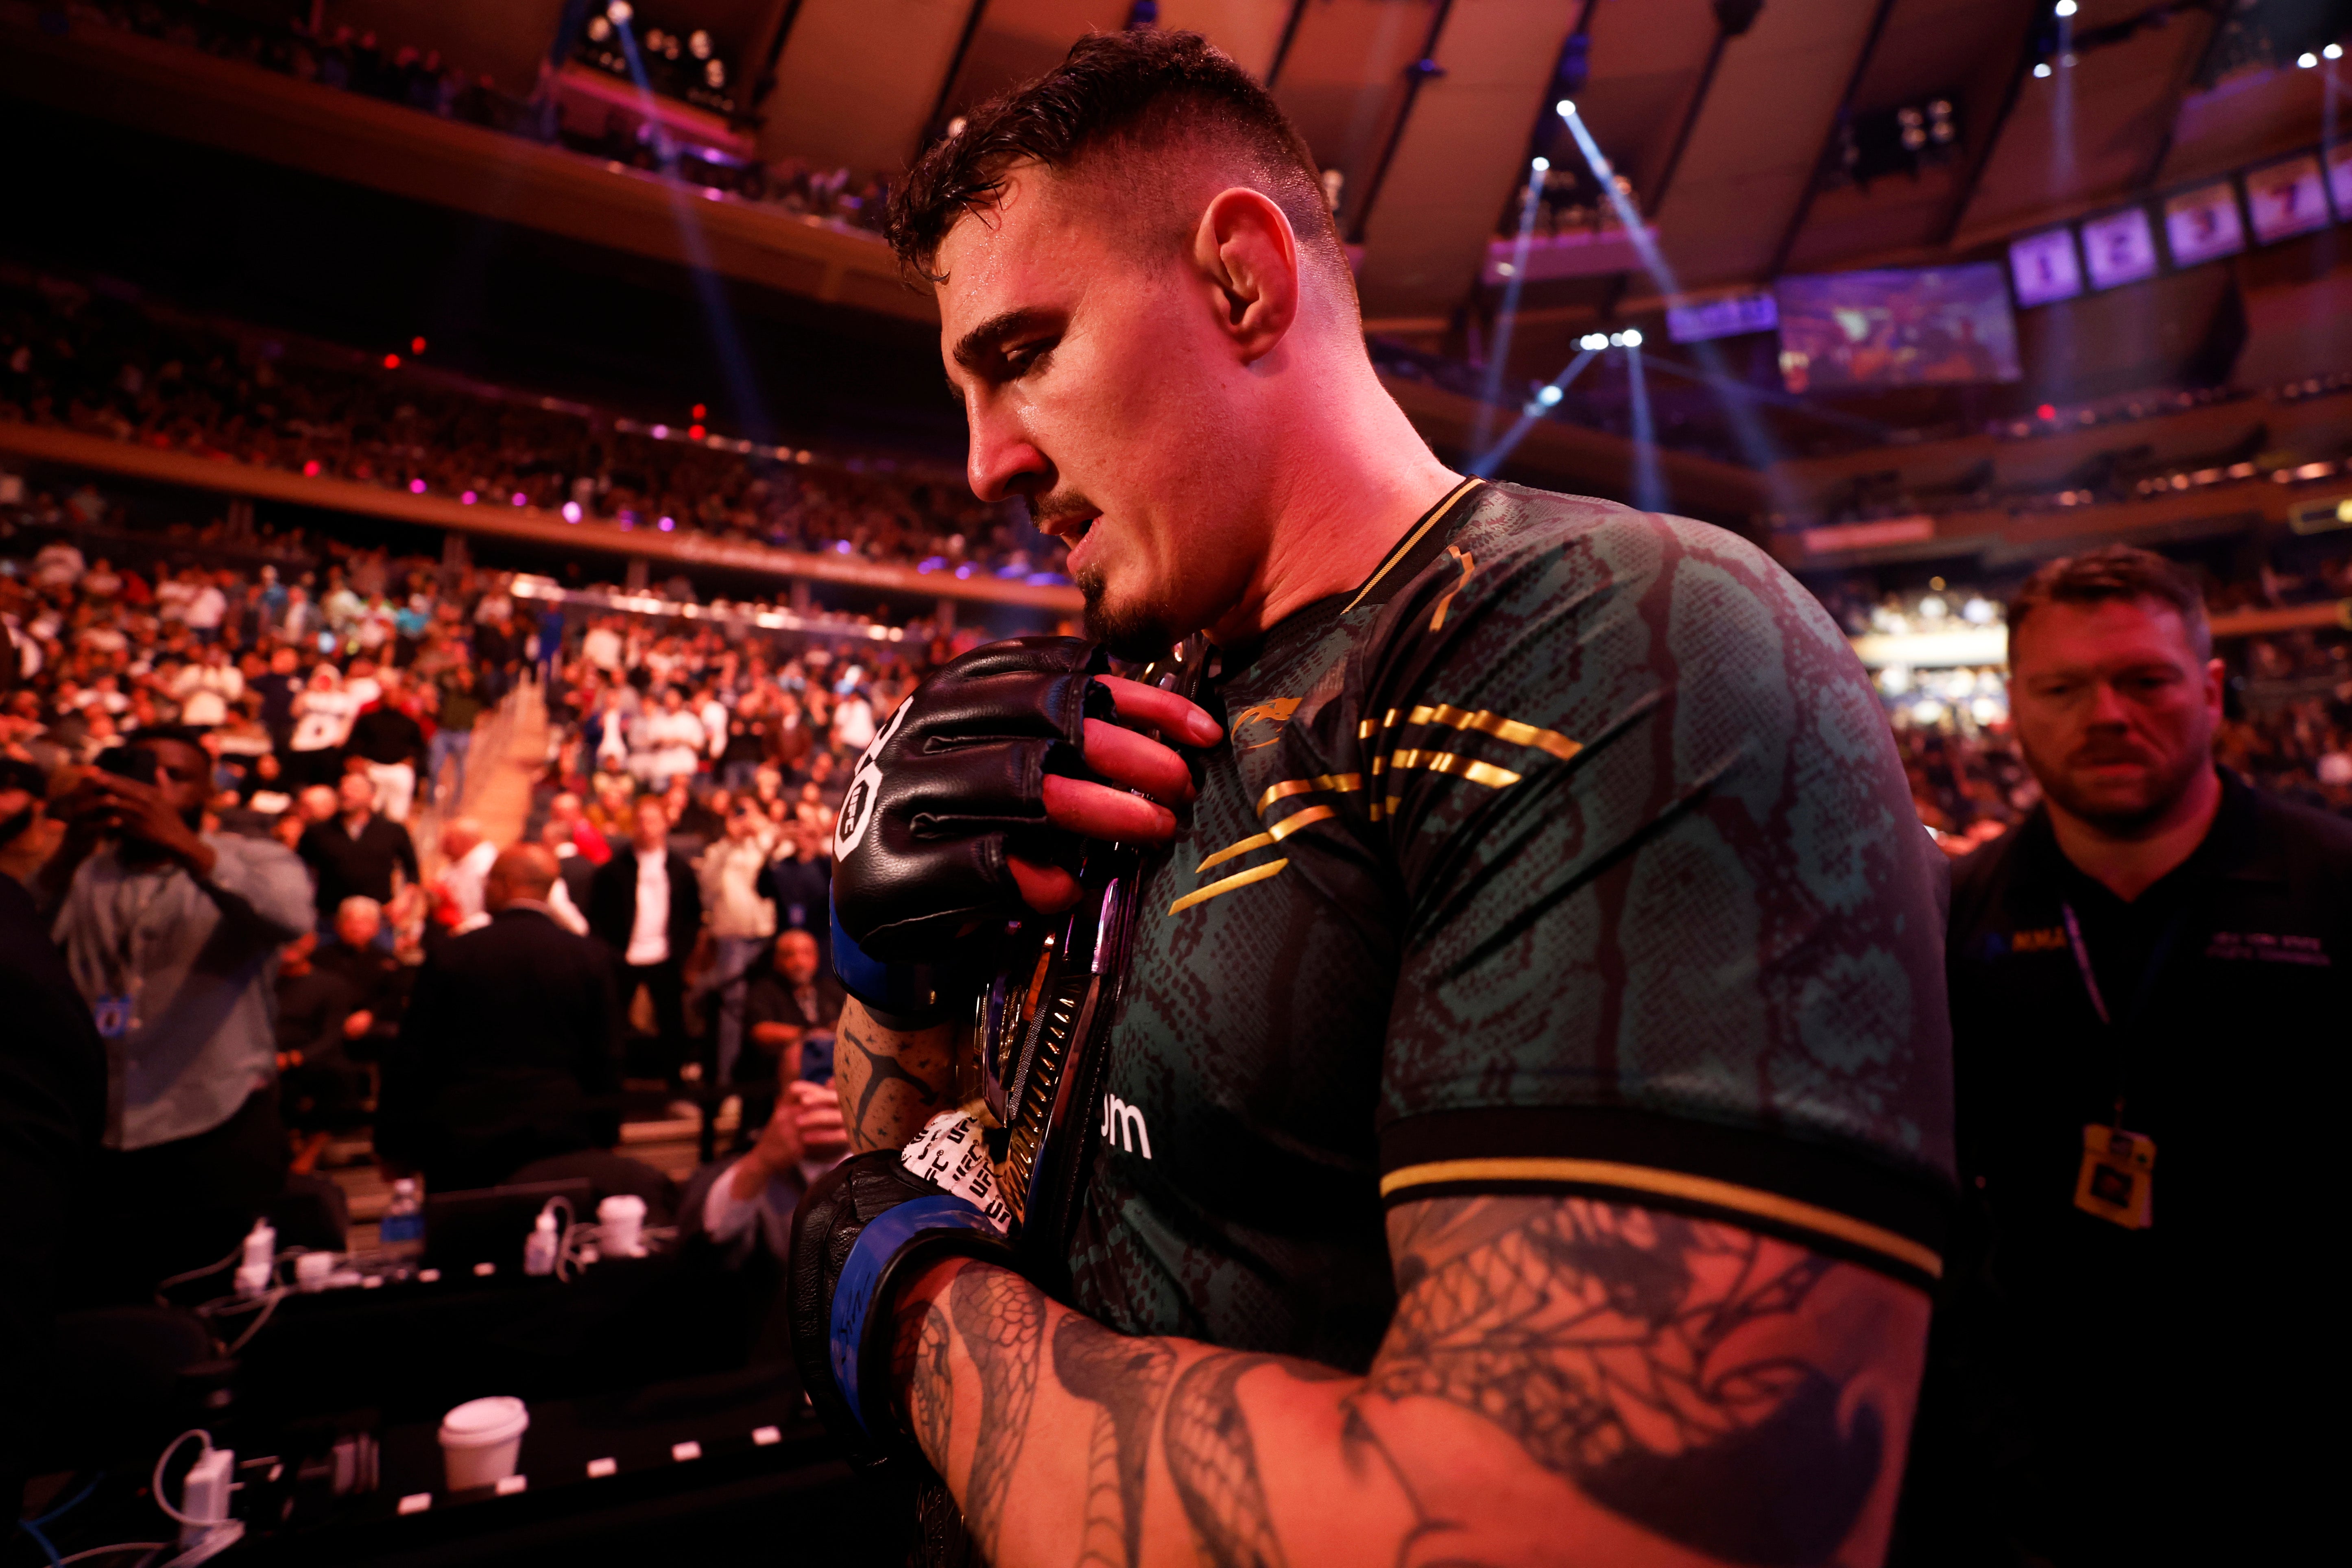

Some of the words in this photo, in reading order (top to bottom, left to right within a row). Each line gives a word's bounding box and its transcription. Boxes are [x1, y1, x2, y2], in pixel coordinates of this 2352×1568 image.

[844, 786, 862, 835] UFC
[924, 1157, 949, 1184] FC
[984, 1199, 1012, 1223] UF
